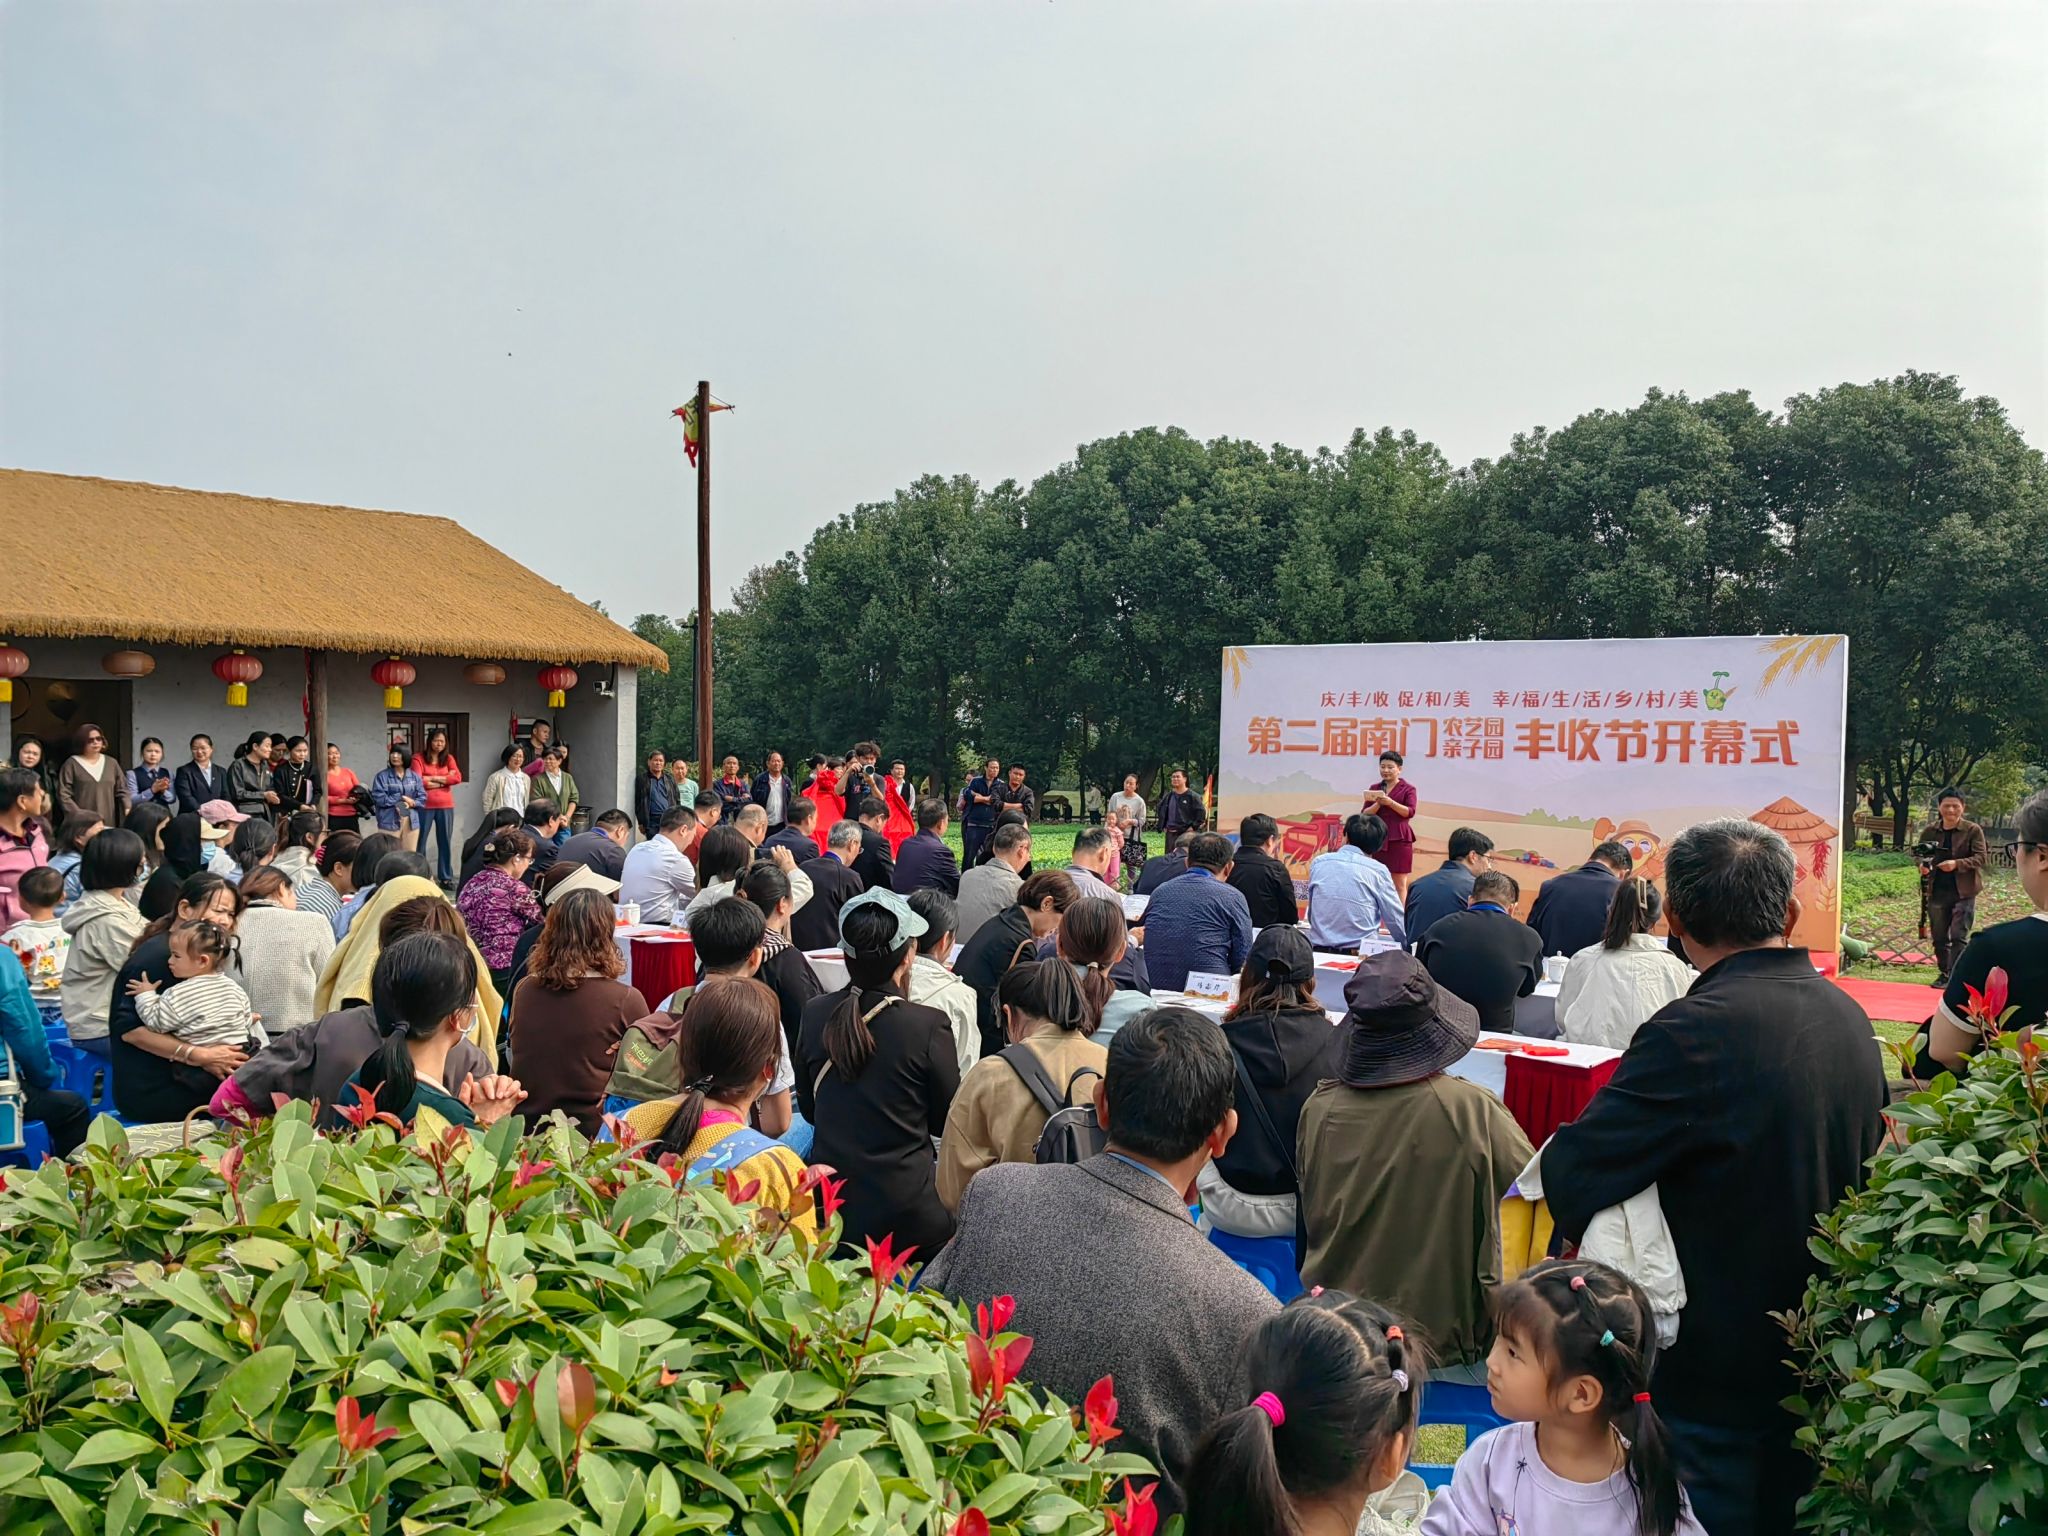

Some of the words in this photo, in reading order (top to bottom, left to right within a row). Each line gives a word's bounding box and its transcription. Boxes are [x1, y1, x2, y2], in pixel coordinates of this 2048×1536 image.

[1492, 689, 1699, 709] 幸/福/生/活/乡/村/美
[1442, 716, 1504, 738] 农艺园
[1247, 715, 1438, 758] 第二届南门
[1512, 717, 1800, 766] 丰收节开幕式
[1442, 738, 1504, 760] 亲子园
